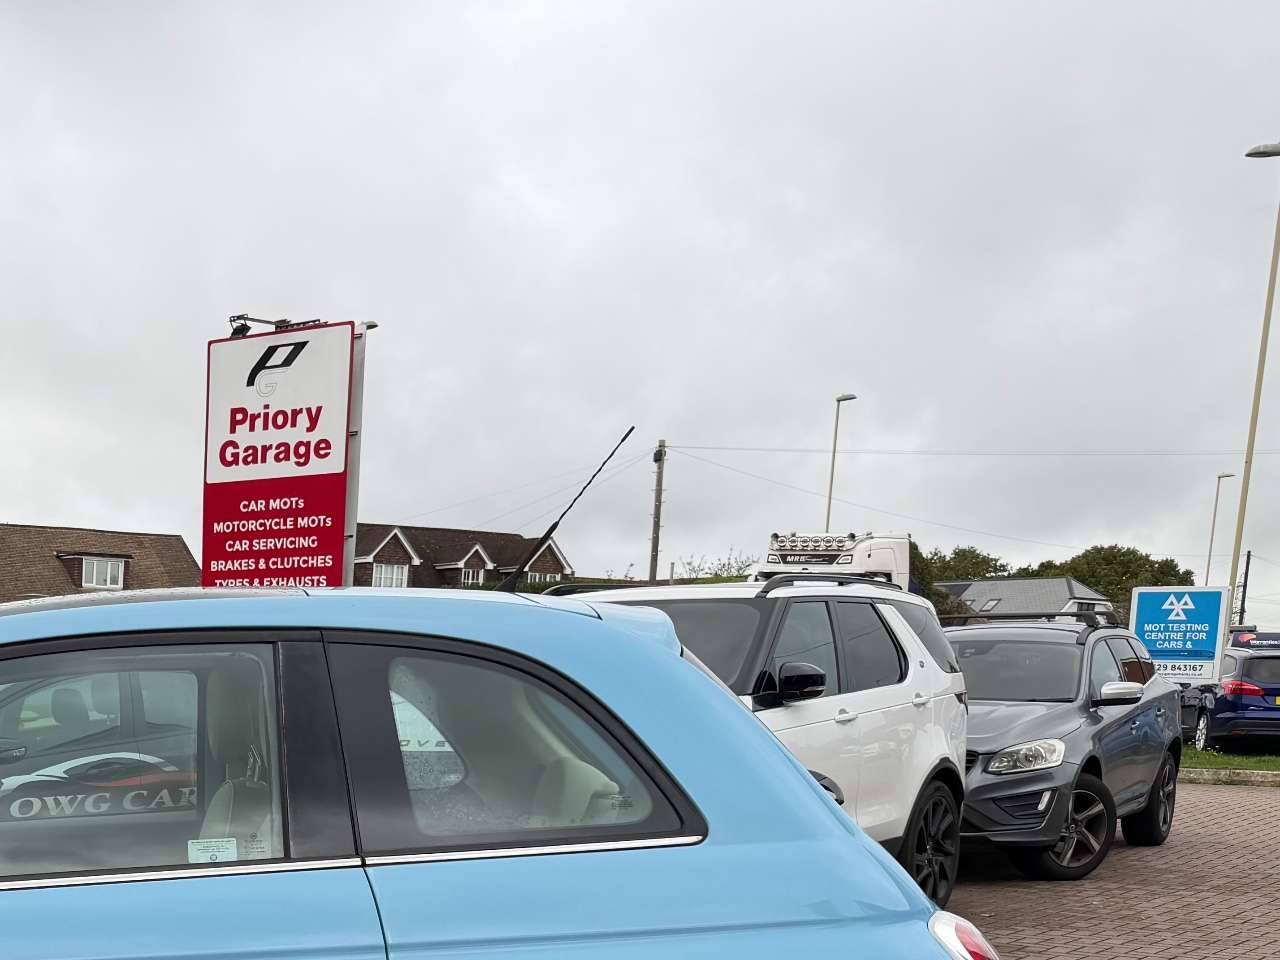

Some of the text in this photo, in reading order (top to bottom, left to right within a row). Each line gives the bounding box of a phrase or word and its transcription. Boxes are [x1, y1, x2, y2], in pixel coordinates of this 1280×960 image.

[229, 404, 323, 434] Priory
[219, 438, 332, 467] Garage
[240, 497, 304, 512] CAR MOTs
[213, 515, 332, 533] MOTORCYCLE MOTs
[225, 536, 318, 552] CAR SERVICING
[210, 555, 333, 572] BRAKES & CLUTCHES
[263, 576, 327, 587] EXHAUSTS
[1144, 623, 1209, 631] MOT TESTING
[1144, 632, 1207, 640] CENTRE FOR
[1156, 641, 1193, 649] CARS &
[1170, 664, 1204, 672] 843167
[9, 792, 112, 818] OWG
